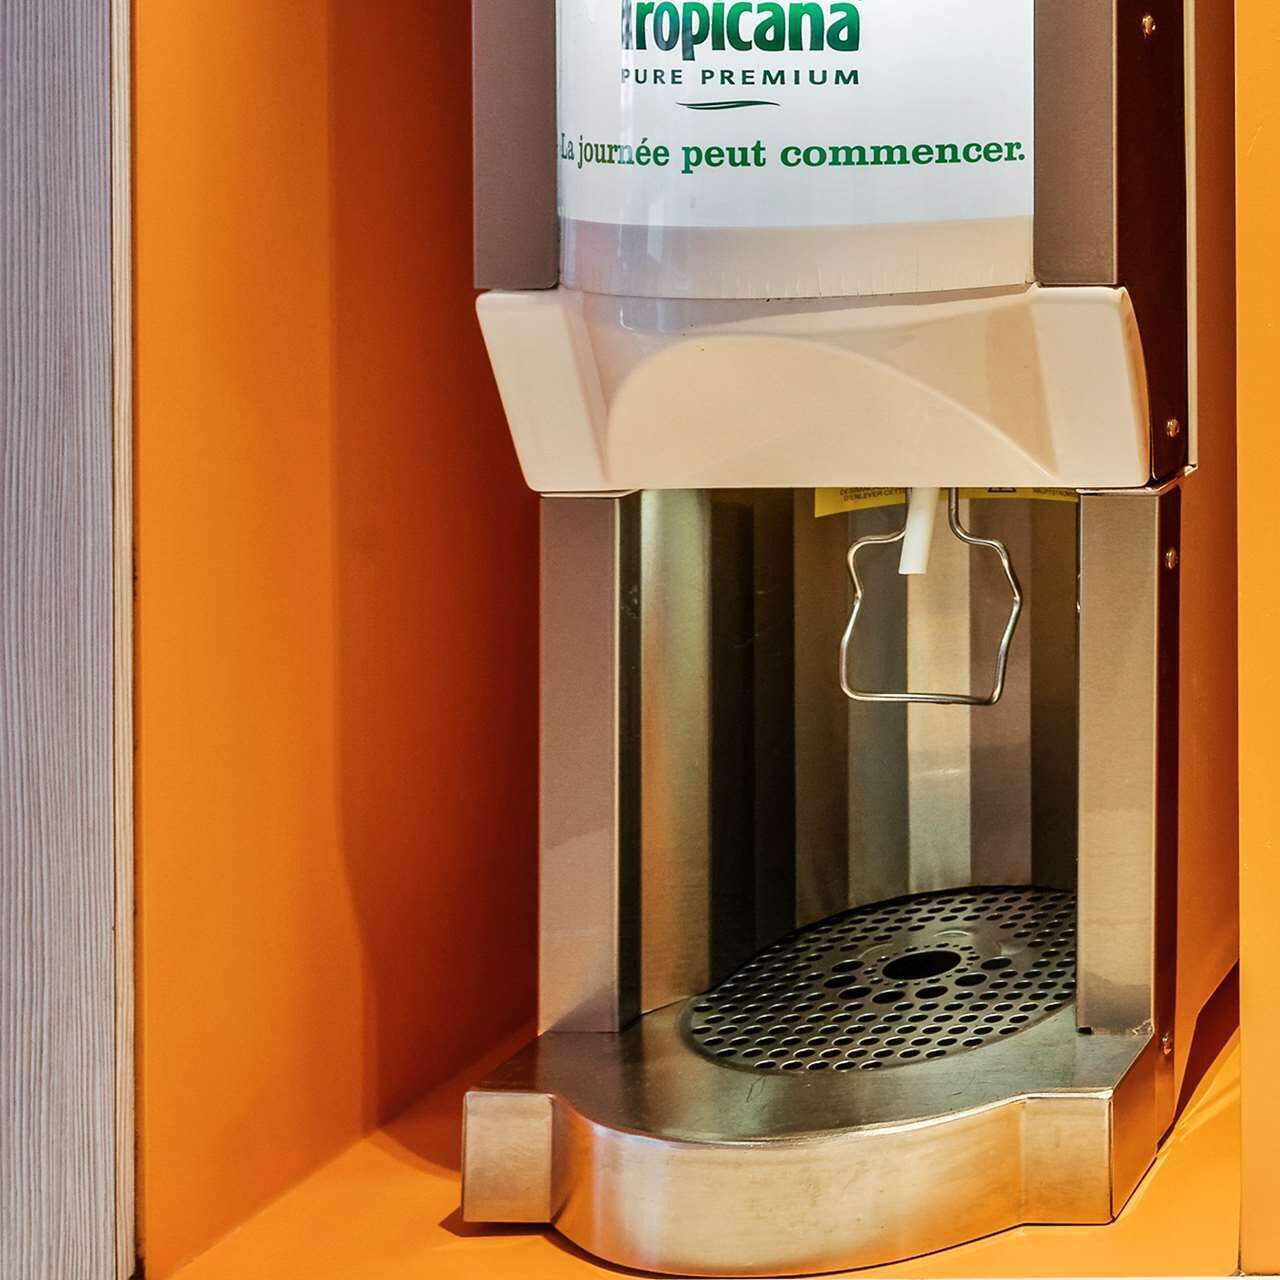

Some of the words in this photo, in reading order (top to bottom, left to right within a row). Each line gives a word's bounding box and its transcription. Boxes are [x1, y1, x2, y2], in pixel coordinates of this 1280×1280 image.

[621, 69, 683, 85] PURE
[700, 69, 859, 85] PREMIUM
[560, 132, 575, 160] La
[577, 137, 670, 169] journée
[681, 139, 766, 174] peut
[780, 141, 1025, 167] commencer.
